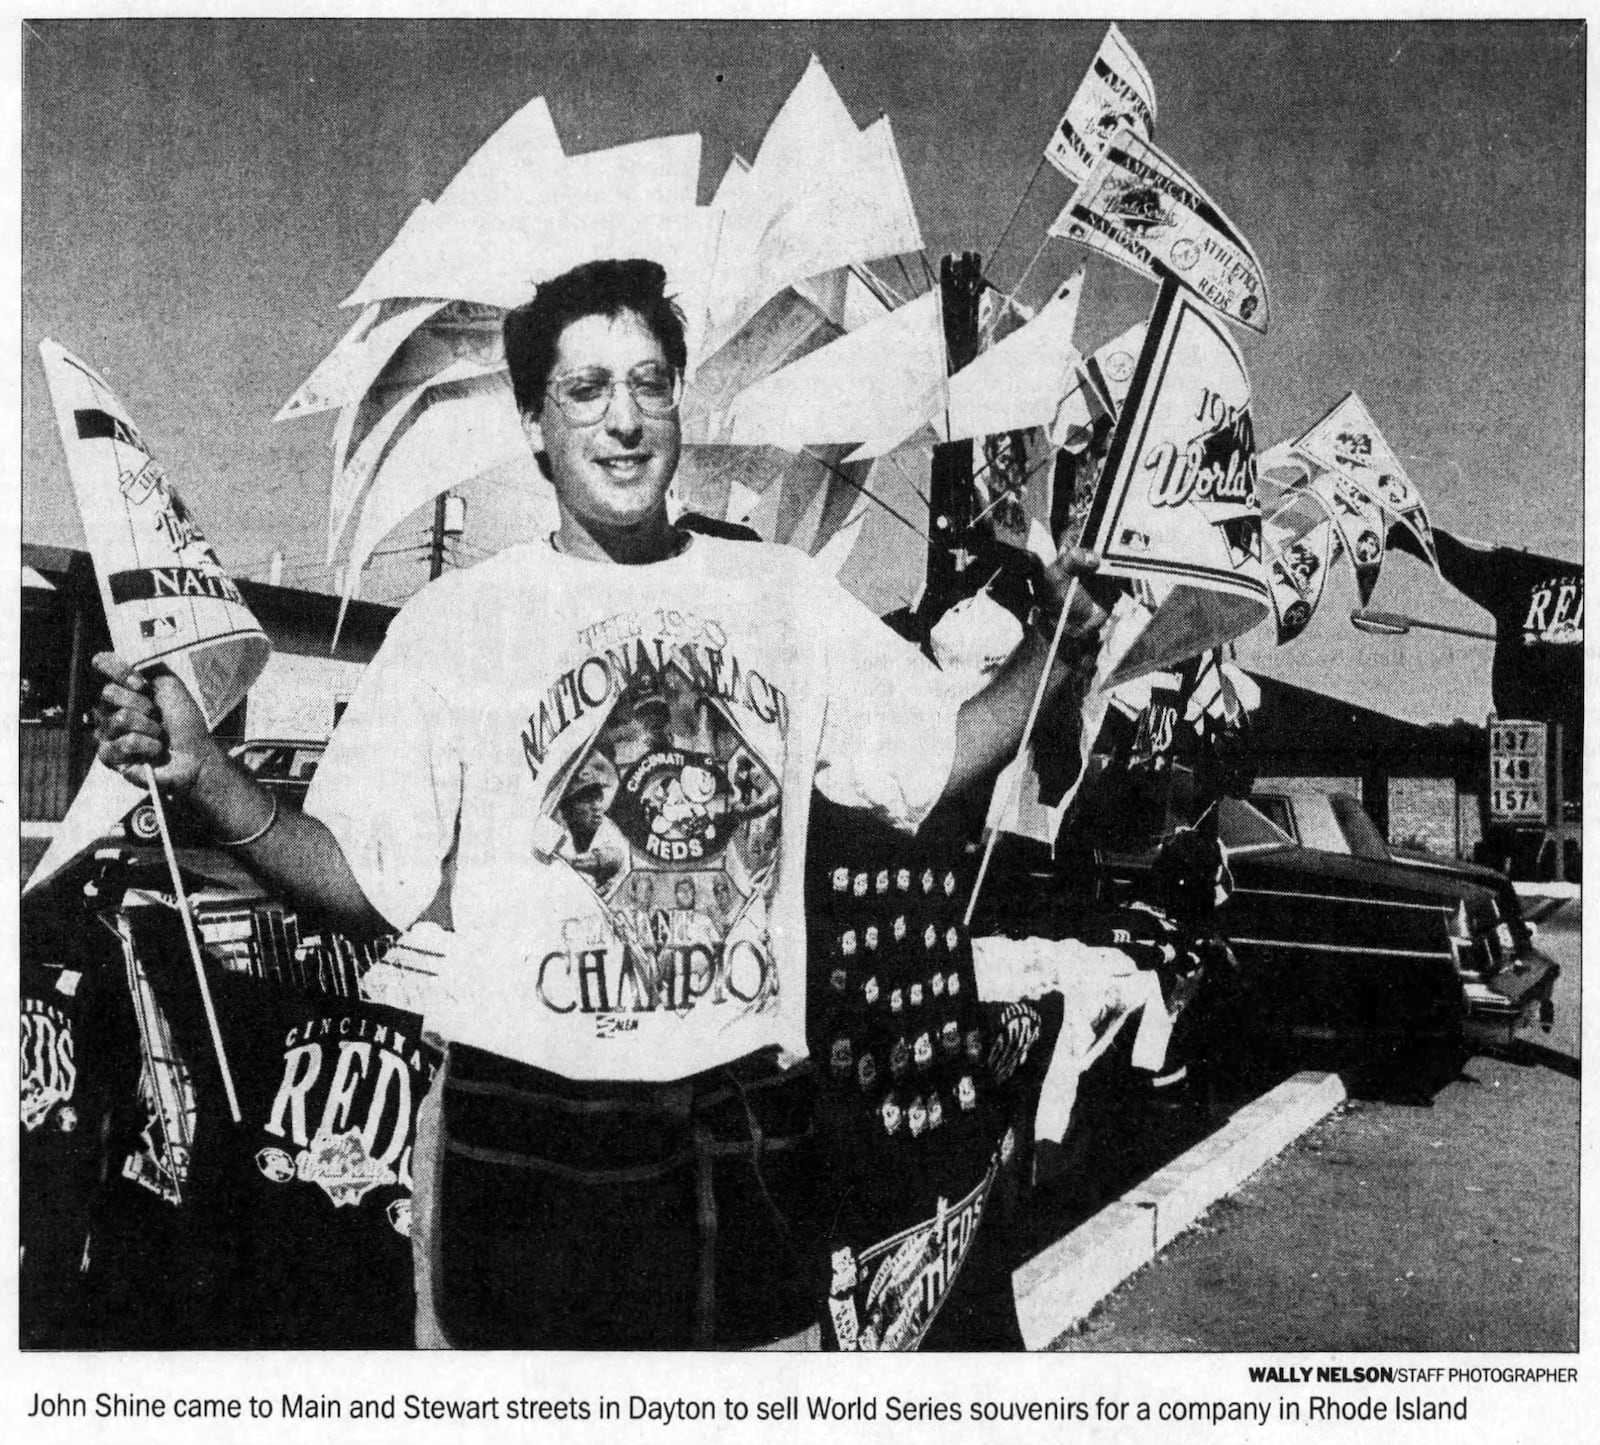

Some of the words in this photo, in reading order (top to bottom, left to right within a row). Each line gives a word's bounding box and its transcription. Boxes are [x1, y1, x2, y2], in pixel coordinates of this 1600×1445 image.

[1198, 277, 1232, 312] REDS
[1144, 441, 1248, 508] World
[1493, 730, 1530, 751] 137
[645, 833, 704, 861] REDS
